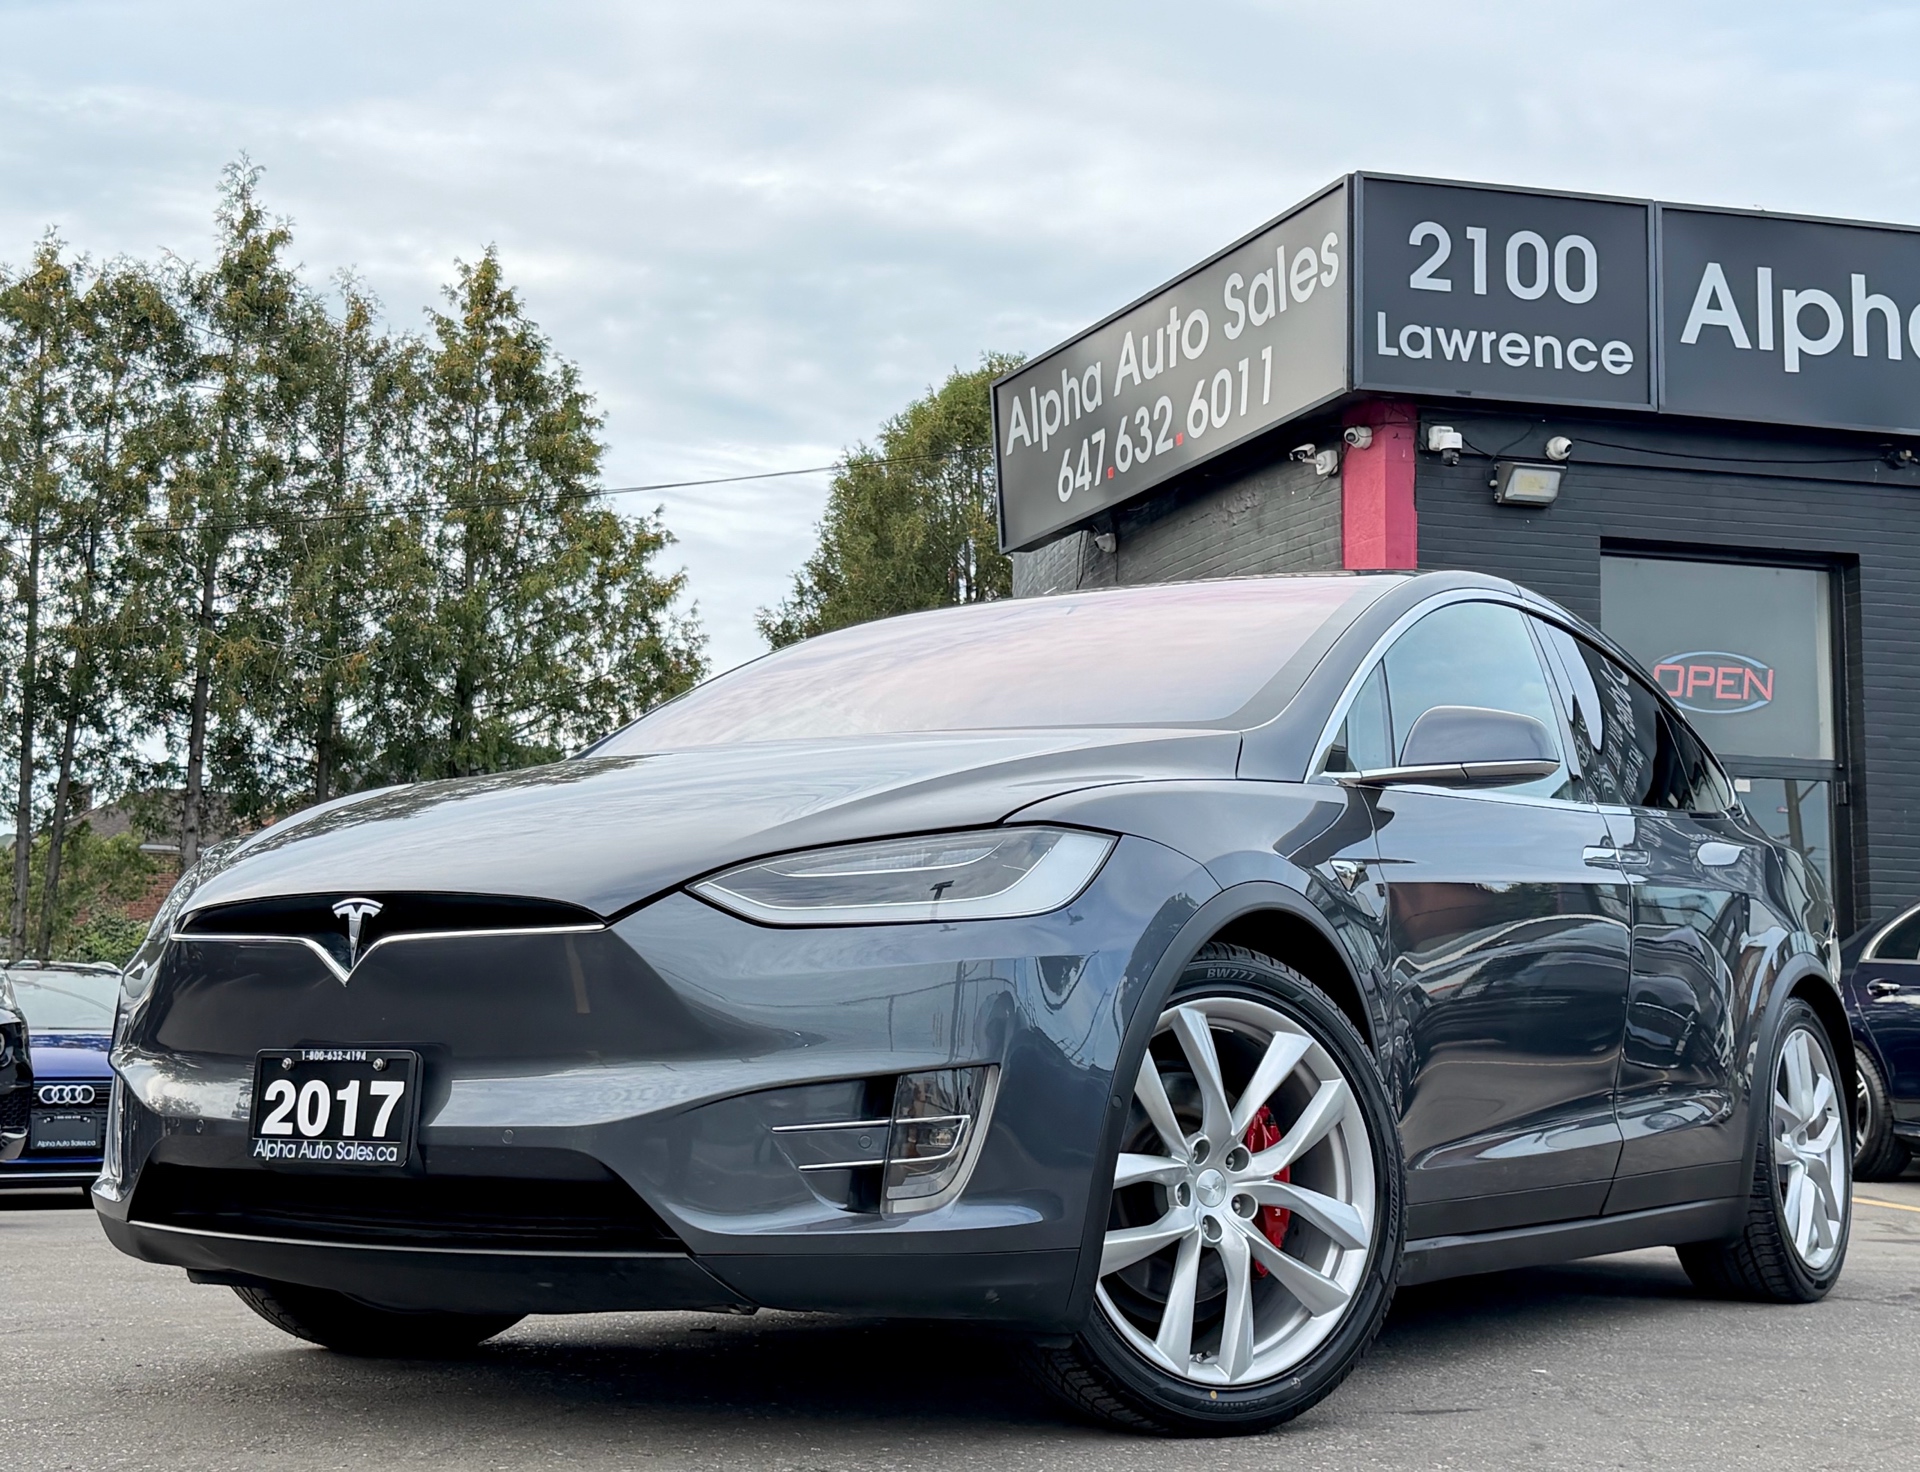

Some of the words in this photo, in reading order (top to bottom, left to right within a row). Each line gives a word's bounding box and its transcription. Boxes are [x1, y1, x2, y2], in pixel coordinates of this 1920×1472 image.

[1409, 222, 1598, 304] 2100
[1004, 361, 1102, 456] Alpha
[1113, 305, 1209, 398] Auto
[1223, 231, 1340, 341] Sales
[1379, 311, 1634, 375] Lawrence
[1681, 262, 1920, 373] Alph
[1057, 345, 1273, 503] 647.632.6011
[1653, 664, 1775, 702] OPEN
[1206, 967, 1257, 981] BW777
[301, 1049, 368, 1062] 1-800-632-4194
[260, 1079, 405, 1138] 2017
[253, 1138, 297, 1162] Alpha
[298, 1139, 333, 1161] Auto
[335, 1141, 399, 1163] Sales.ca
